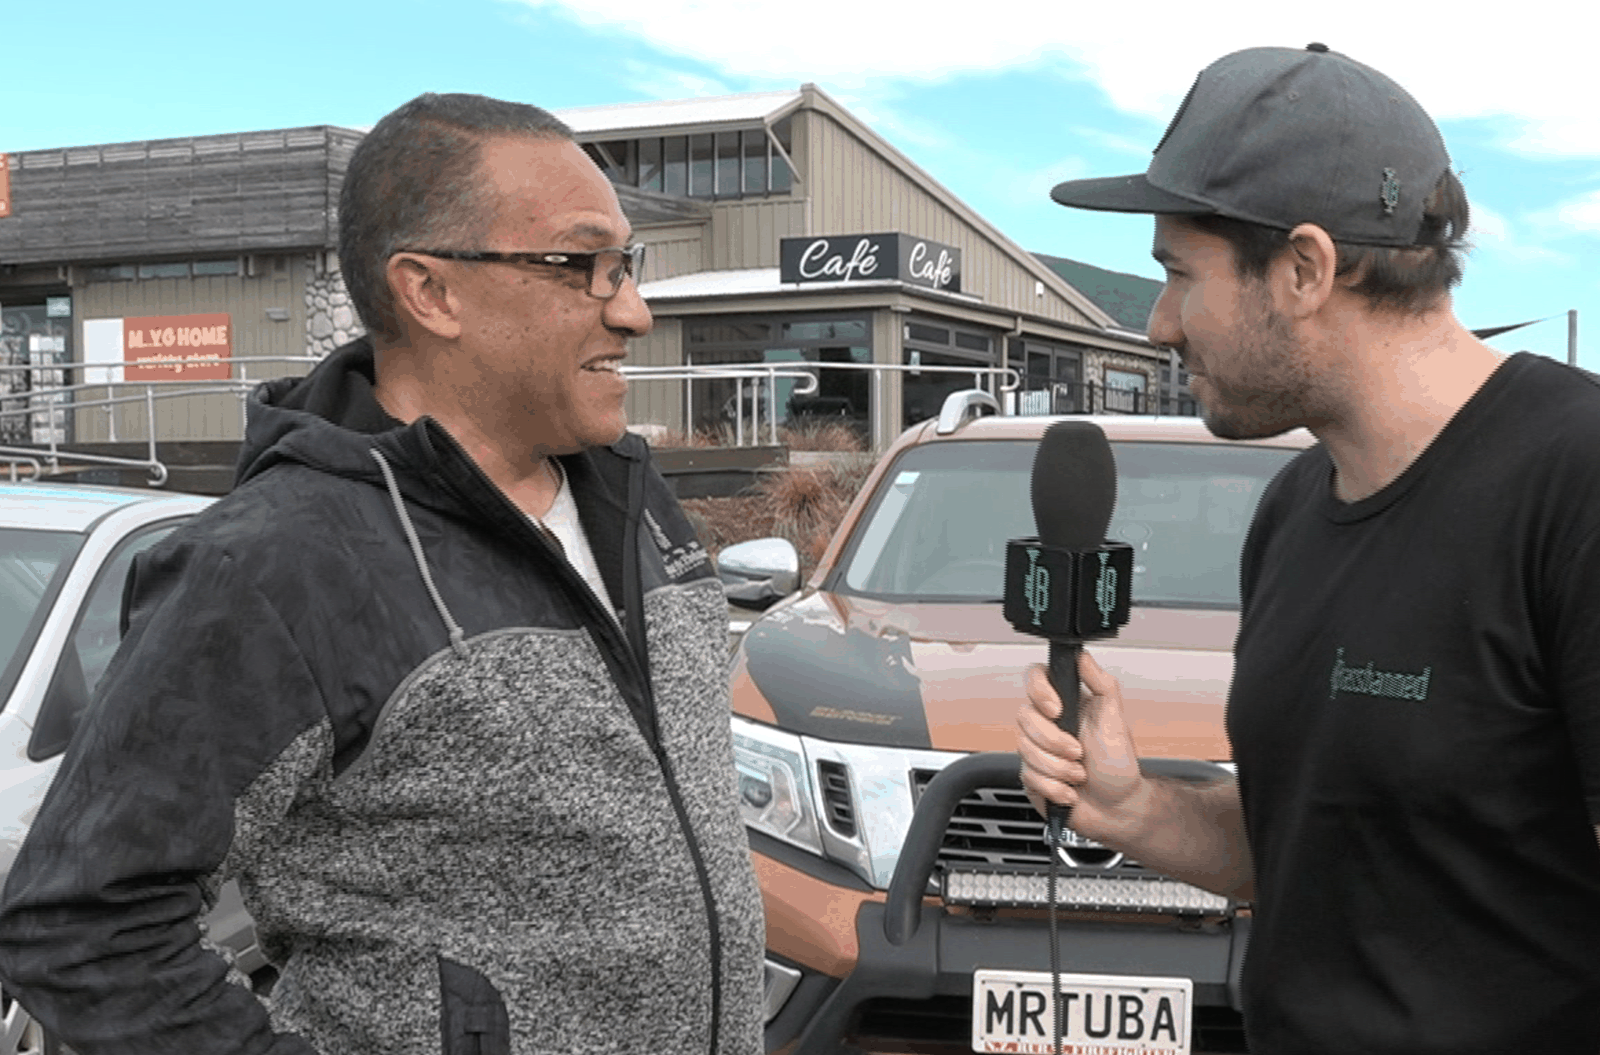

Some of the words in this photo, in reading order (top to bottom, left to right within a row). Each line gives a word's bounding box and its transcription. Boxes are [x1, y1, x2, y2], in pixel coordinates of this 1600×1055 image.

[799, 238, 880, 283] Café
[909, 241, 953, 290] Café
[177, 324, 228, 348] HOME
[985, 989, 1177, 1042] MRTUBA
